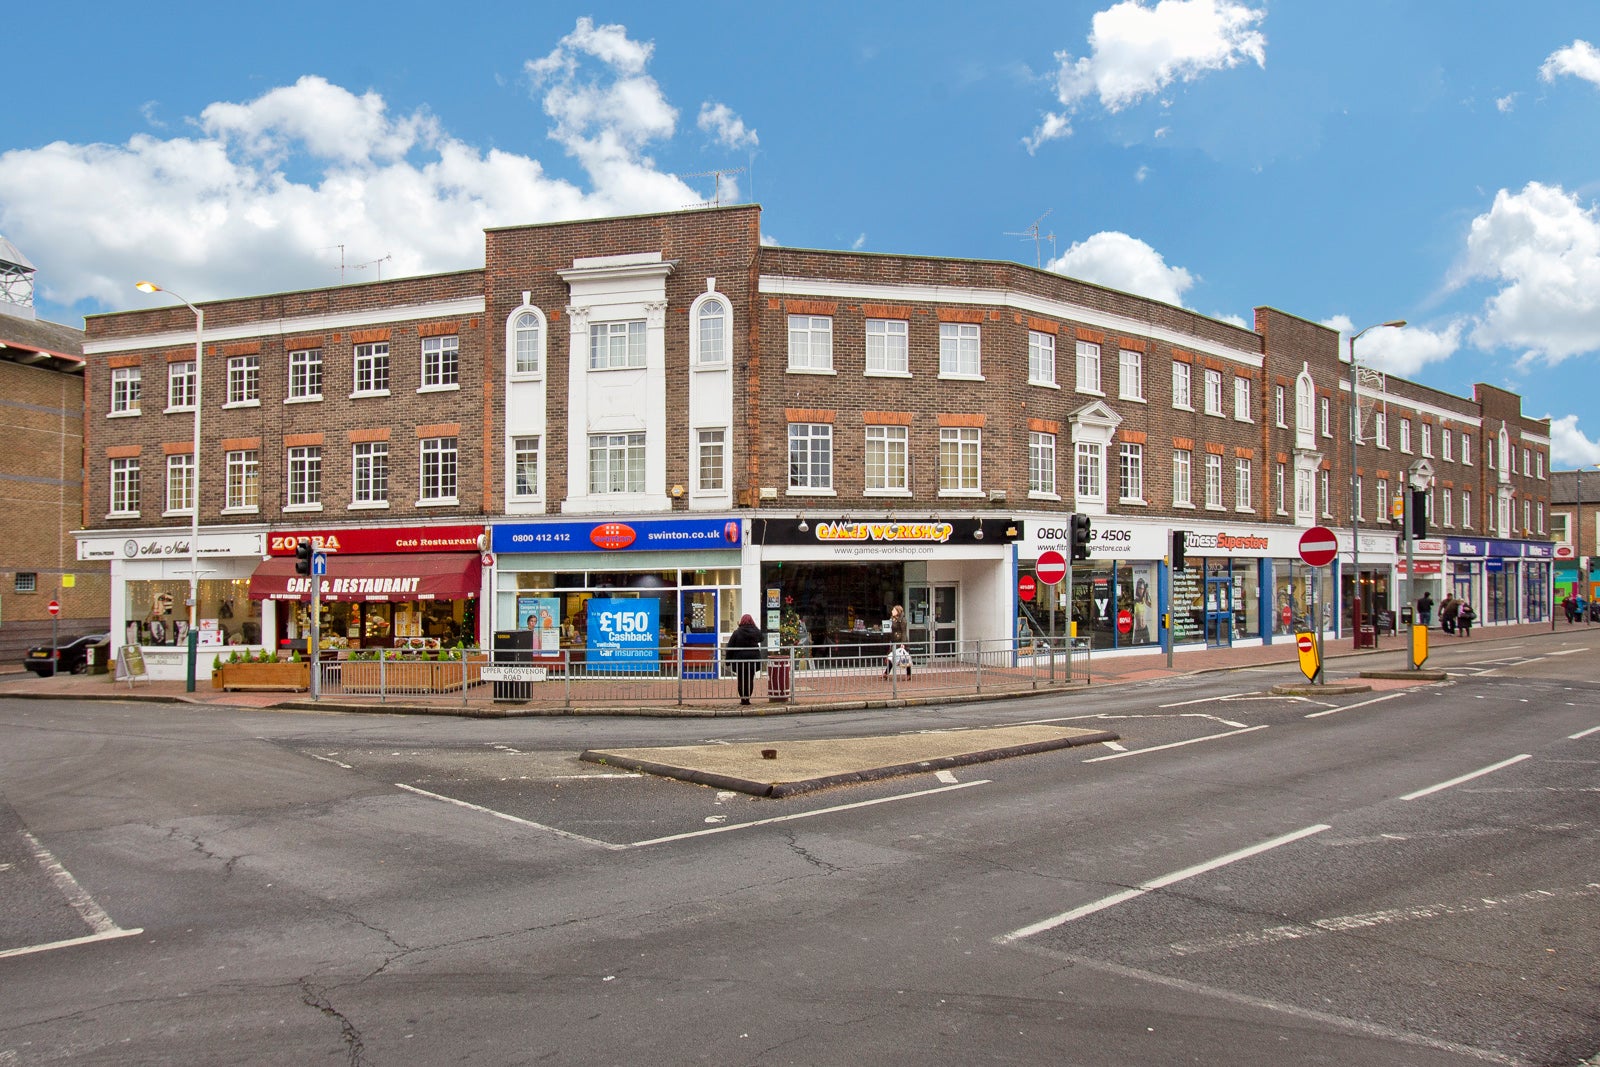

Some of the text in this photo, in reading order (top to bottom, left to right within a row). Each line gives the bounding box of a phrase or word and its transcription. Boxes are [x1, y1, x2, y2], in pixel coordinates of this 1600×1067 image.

[648, 530, 720, 540] swinton.co.uk
[816, 521, 953, 542] GAMES WORKSHOP
[1101, 530, 1131, 541] 4506
[420, 538, 476, 546] Restaurant
[512, 533, 570, 542] 0800 412 412
[141, 541, 190, 555] Mai Nails
[834, 546, 934, 555] www.games-workshop.com
[287, 577, 420, 593] CAF & RESTAURANT
[608, 632, 653, 641] Cashback
